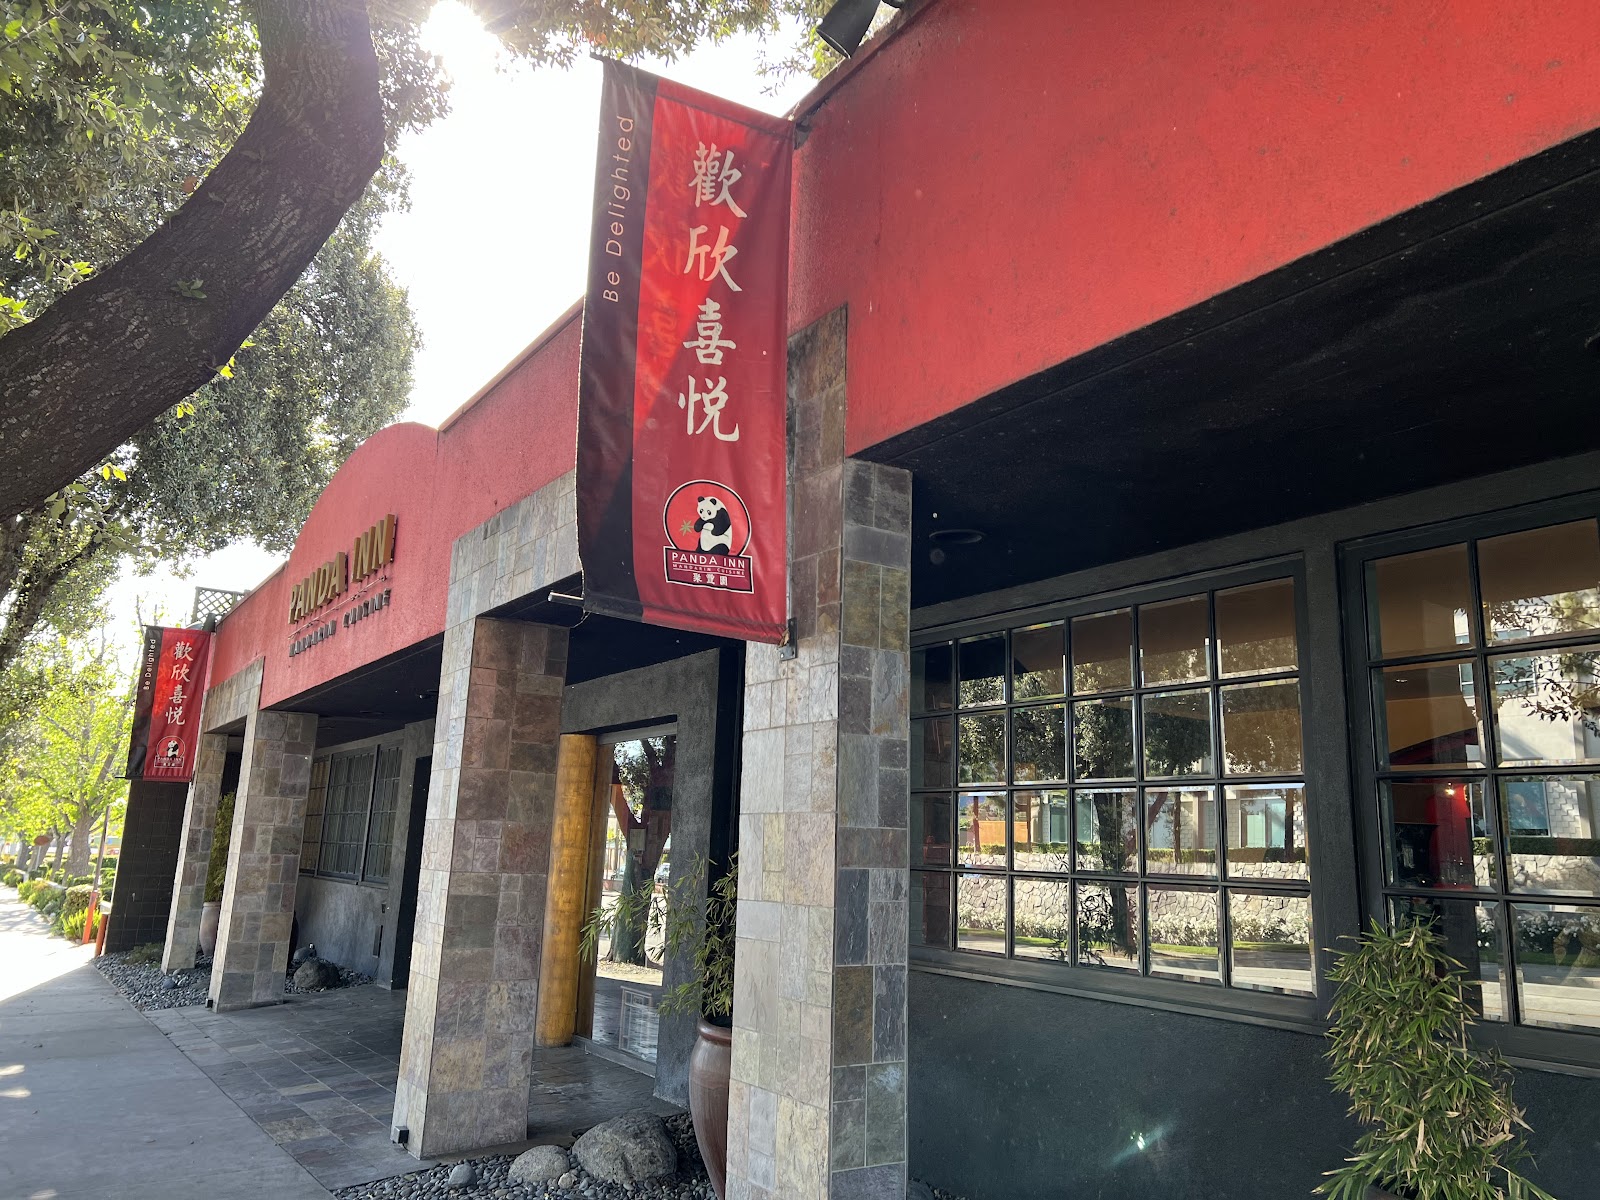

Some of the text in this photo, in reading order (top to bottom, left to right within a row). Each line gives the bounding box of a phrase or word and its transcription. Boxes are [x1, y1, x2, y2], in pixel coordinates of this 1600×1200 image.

[603, 116, 634, 302] Be Delighted
[288, 513, 397, 624] PANDA INN
[672, 552, 745, 569] PANDA INN
[672, 563, 745, 576] MANDARIN CUISINE
[144, 638, 156, 678] Delighted
